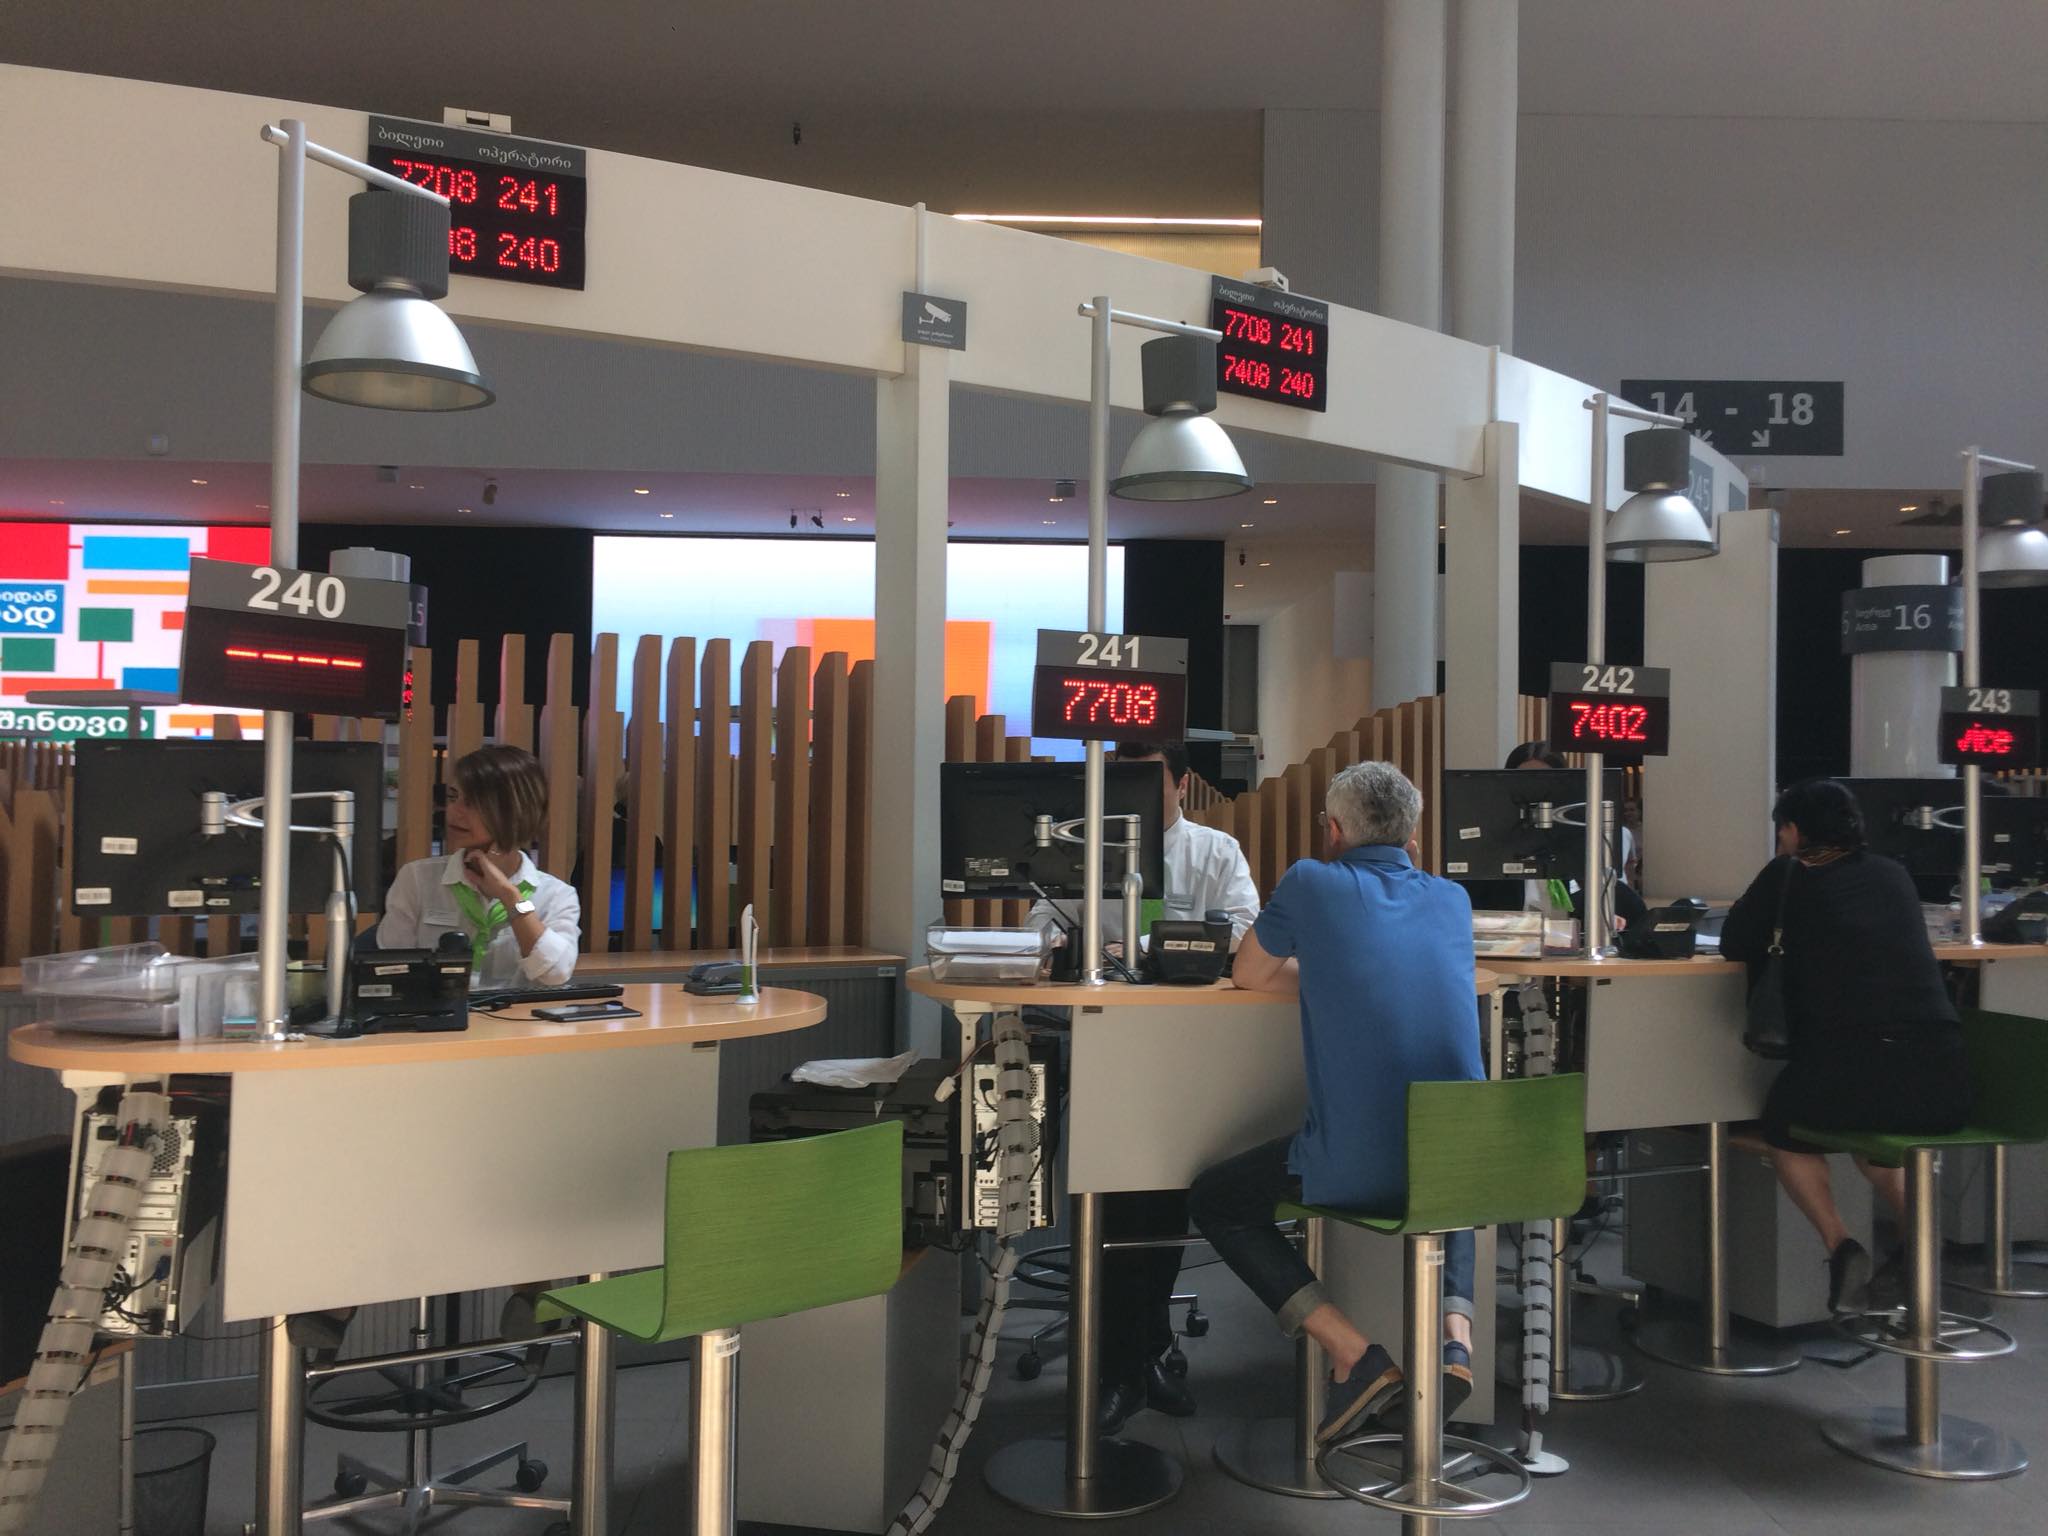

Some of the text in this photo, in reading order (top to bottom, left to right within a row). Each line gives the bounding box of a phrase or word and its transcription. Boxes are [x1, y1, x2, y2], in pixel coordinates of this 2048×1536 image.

[378, 126, 572, 168] ბილეთი ოპერატორი
[498, 176, 558, 216] 241
[498, 233, 560, 273] 240
[1224, 309, 1313, 355] 7708 241
[1224, 355, 1314, 399] 7408 240
[1650, 391, 1698, 425] 14
[1768, 392, 1815, 426] 18
[0, 589, 58, 605] იდან
[247, 566, 346, 620] 240
[0, 604, 56, 629] ად
[1895, 604, 1932, 630] 16
[1076, 633, 1140, 668] 241
[1581, 665, 1635, 694] 242
[1063, 679, 1158, 725] 7708
[1967, 688, 2011, 713] 243
[1570, 702, 1648, 740] 7402
